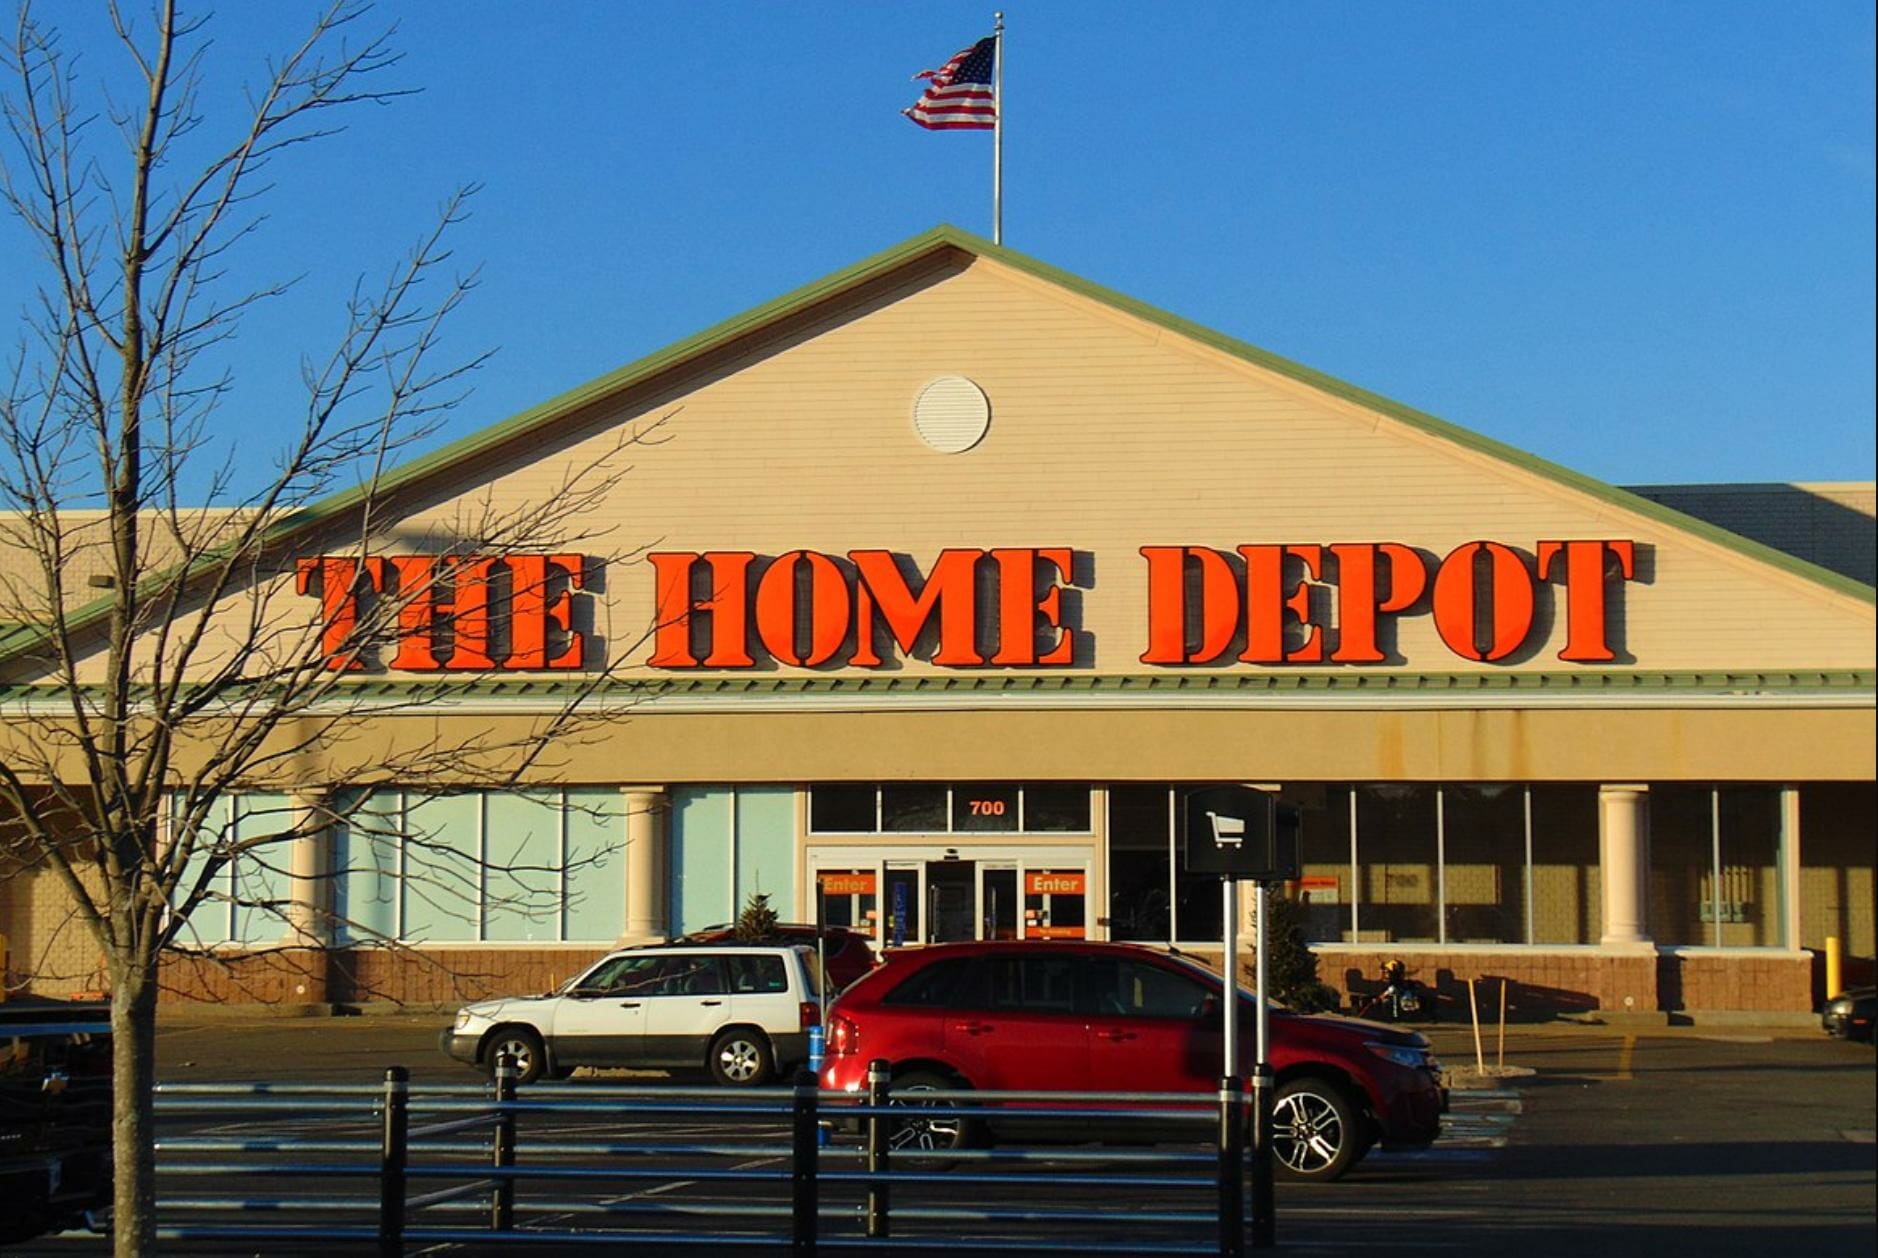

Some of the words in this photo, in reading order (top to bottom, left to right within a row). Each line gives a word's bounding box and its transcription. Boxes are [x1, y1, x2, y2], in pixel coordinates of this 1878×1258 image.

[296, 553, 582, 670] THE
[646, 547, 1073, 668] HOME
[1139, 540, 1634, 664] DEPOT
[969, 801, 1004, 815] 700
[824, 877, 868, 892] Enter
[1034, 877, 1079, 892] Enter
